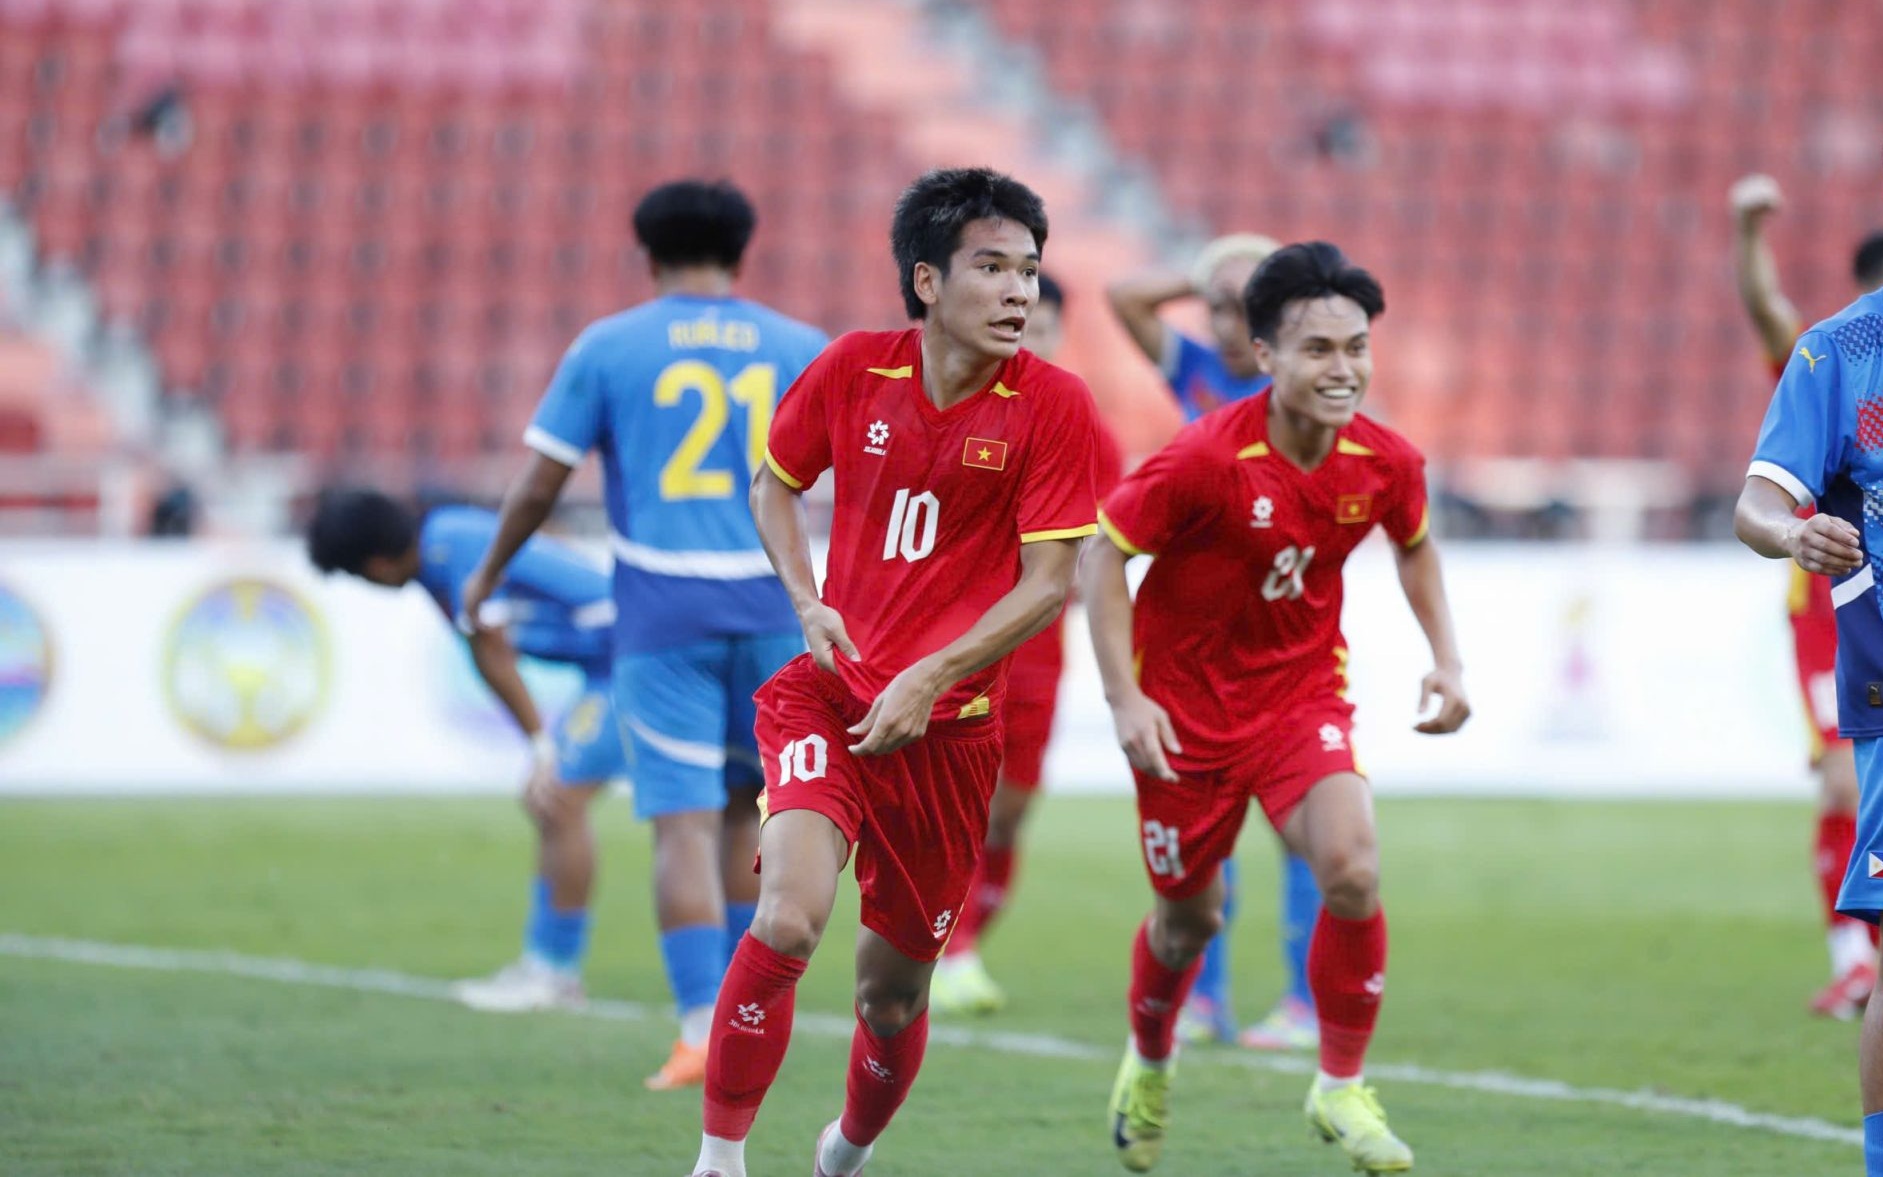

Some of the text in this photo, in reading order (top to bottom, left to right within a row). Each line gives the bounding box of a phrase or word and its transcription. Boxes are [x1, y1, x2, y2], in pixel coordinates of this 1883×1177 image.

[653, 360, 776, 501] 21
[883, 488, 940, 563] 10
[1261, 545, 1316, 602] 21
[779, 733, 827, 786] 10
[1144, 819, 1186, 879] 21
